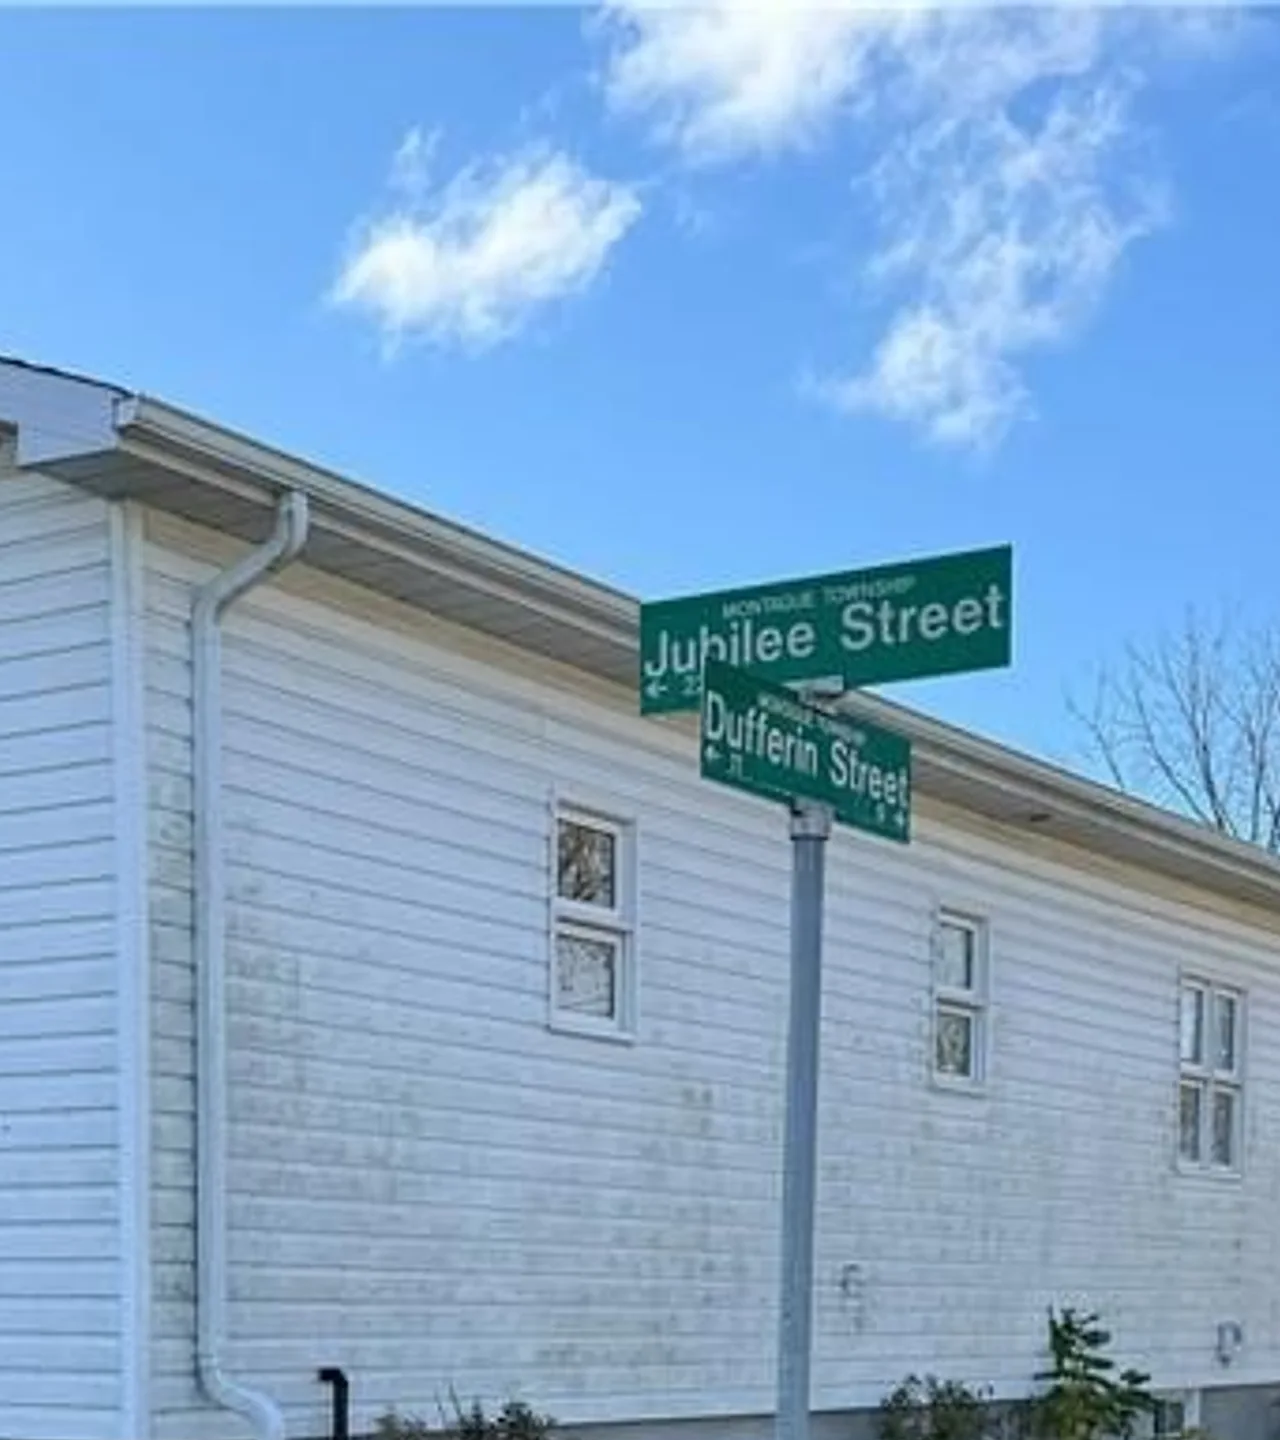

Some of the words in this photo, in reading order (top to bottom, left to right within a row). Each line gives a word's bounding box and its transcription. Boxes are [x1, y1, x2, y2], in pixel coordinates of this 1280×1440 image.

[644, 622, 816, 677] Jubilee
[840, 583, 1005, 651] Street
[705, 690, 818, 777] Dufferin
[830, 740, 908, 808] Street
